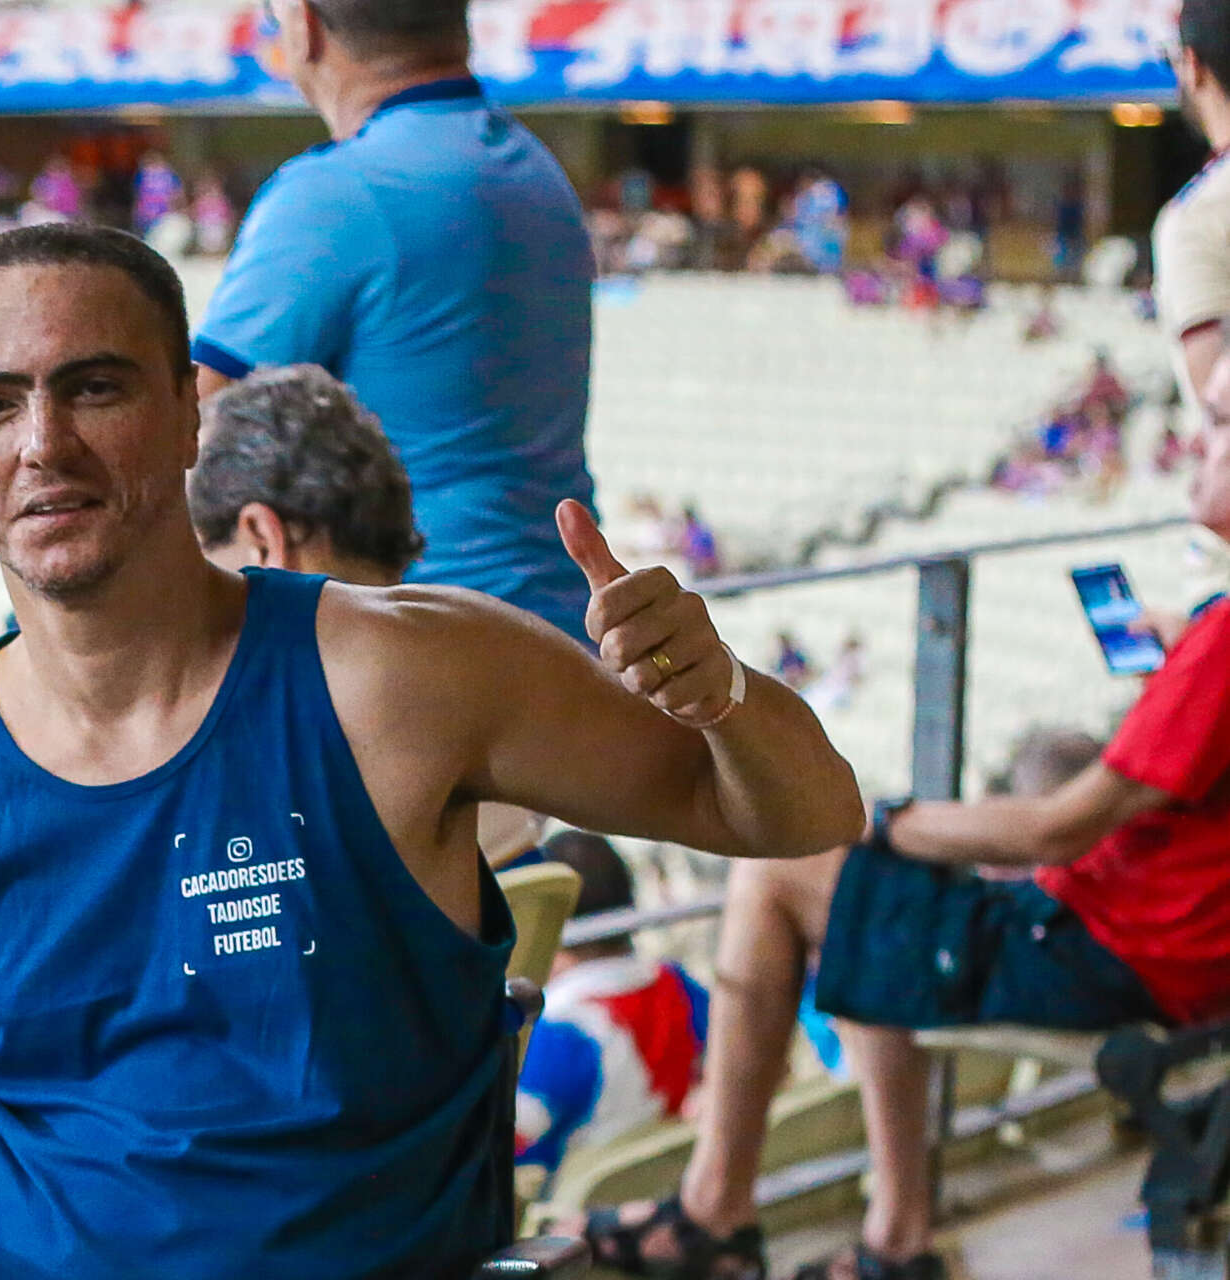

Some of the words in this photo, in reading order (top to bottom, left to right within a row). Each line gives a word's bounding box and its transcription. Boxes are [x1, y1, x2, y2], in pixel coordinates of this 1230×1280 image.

[181, 858, 306, 898] CACADORESDEES
[207, 893, 281, 924] TADIOSDE
[214, 926, 281, 956] FUTEBOL
